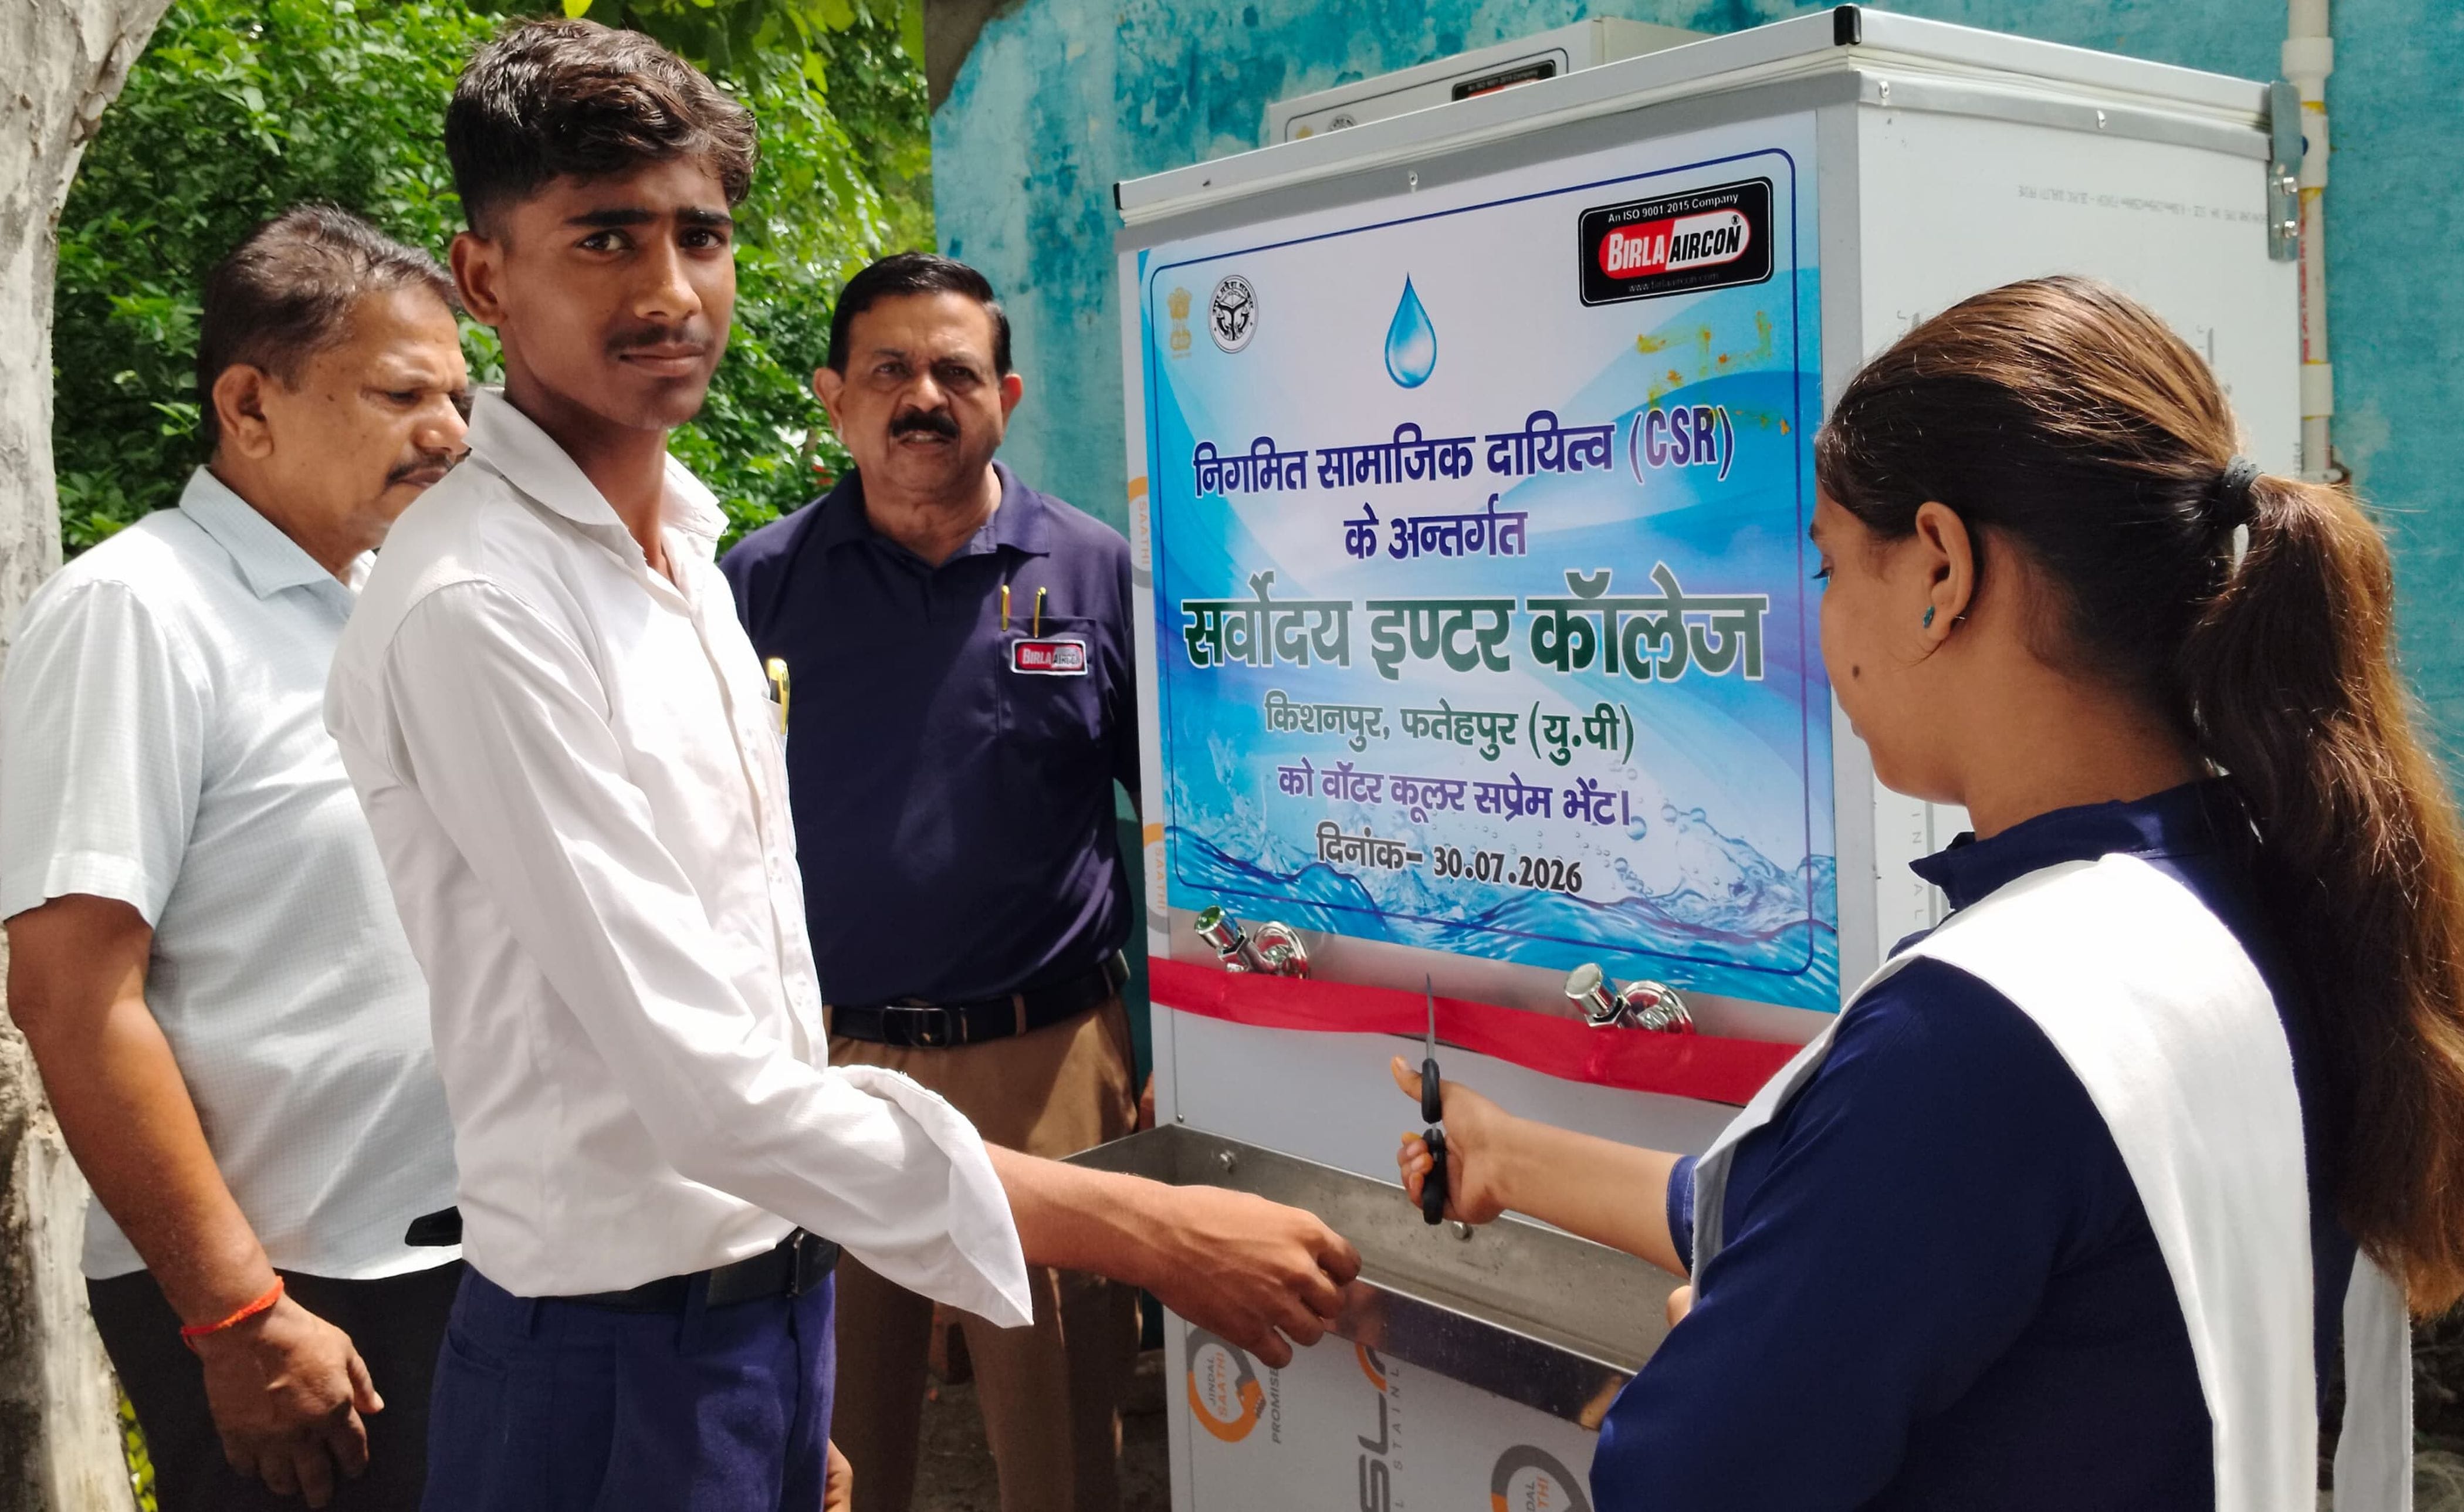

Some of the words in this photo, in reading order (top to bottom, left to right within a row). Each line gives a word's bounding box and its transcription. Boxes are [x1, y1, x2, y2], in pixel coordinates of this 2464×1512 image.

[1608, 213, 1621, 224] An
[1623, 209, 1640, 221] ISO
[1692, 194, 1739, 208] Company
[1607, 232, 1665, 272] BIRLA
[1668, 225, 1742, 263] AIRCON
[1193, 441, 1309, 497] निगमित
[1315, 422, 1476, 489] सामाजिक
[1485, 410, 1615, 476] दायित्व
[1629, 405, 1734, 484] (CSR)
[1343, 502, 1379, 559] के
[1388, 493, 1528, 560] अन्तर्गत
[1183, 569, 1352, 667] सर्वोदय
[1368, 594, 1516, 680] इण्टर
[1527, 563, 1767, 681] कॉलेज
[1021, 647, 1052, 665] BIRLA
[1264, 689, 1390, 752] किशनपुर,
[1400, 698, 1519, 762] फतेहपुर
[1529, 700, 1634, 766] (यु.पी)
[1278, 756, 1314, 797] को
[1321, 760, 1385, 804] वॉटर
[1389, 774, 1467, 823] कूलर
[1473, 772, 1553, 822] सप्रेम
[1433, 845, 1583, 894] 30.07.2026
[1207, 1357, 1217, 1406] JINDAL
[1216, 1351, 1227, 1417] SAATHI
[1269, 1368, 1281, 1445] PROMISE
[1357, 1391, 1391, 1512] SL
[1390, 1368, 1403, 1471] STAINL
[1524, 1480, 1536, 1512] DAL
[1535, 1476, 1549, 1508] THI
